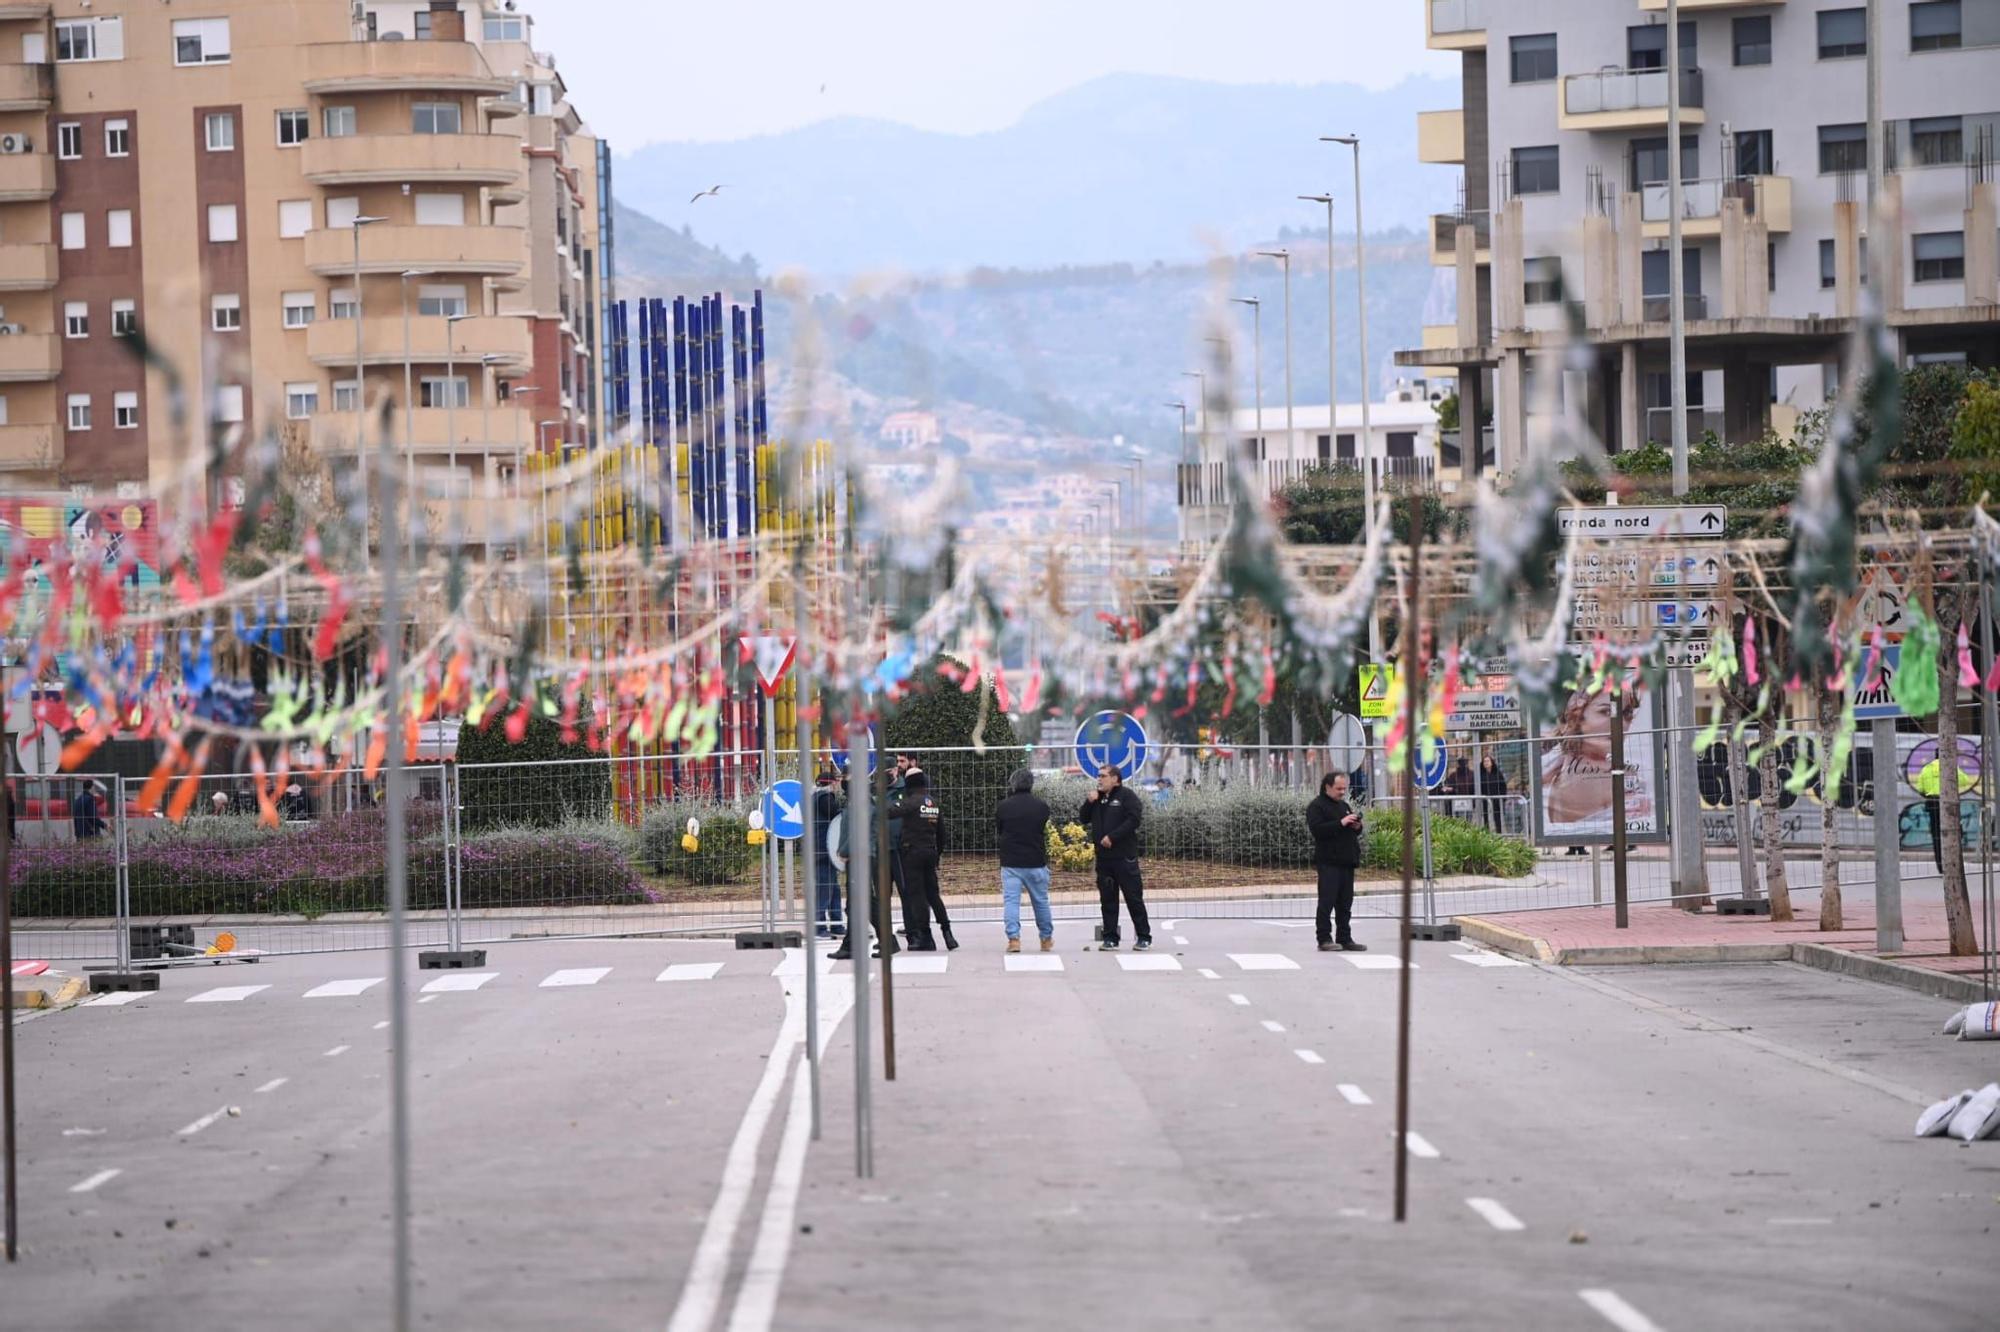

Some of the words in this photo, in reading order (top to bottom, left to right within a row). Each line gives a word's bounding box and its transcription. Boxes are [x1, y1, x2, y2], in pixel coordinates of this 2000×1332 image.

[1562, 516, 1606, 529] ronda
[1614, 515, 1650, 528] nord
[1469, 713, 1508, 721] VALENCIA
[1469, 720, 1518, 728] BARCELONA
[1567, 756, 1600, 775] Miss
